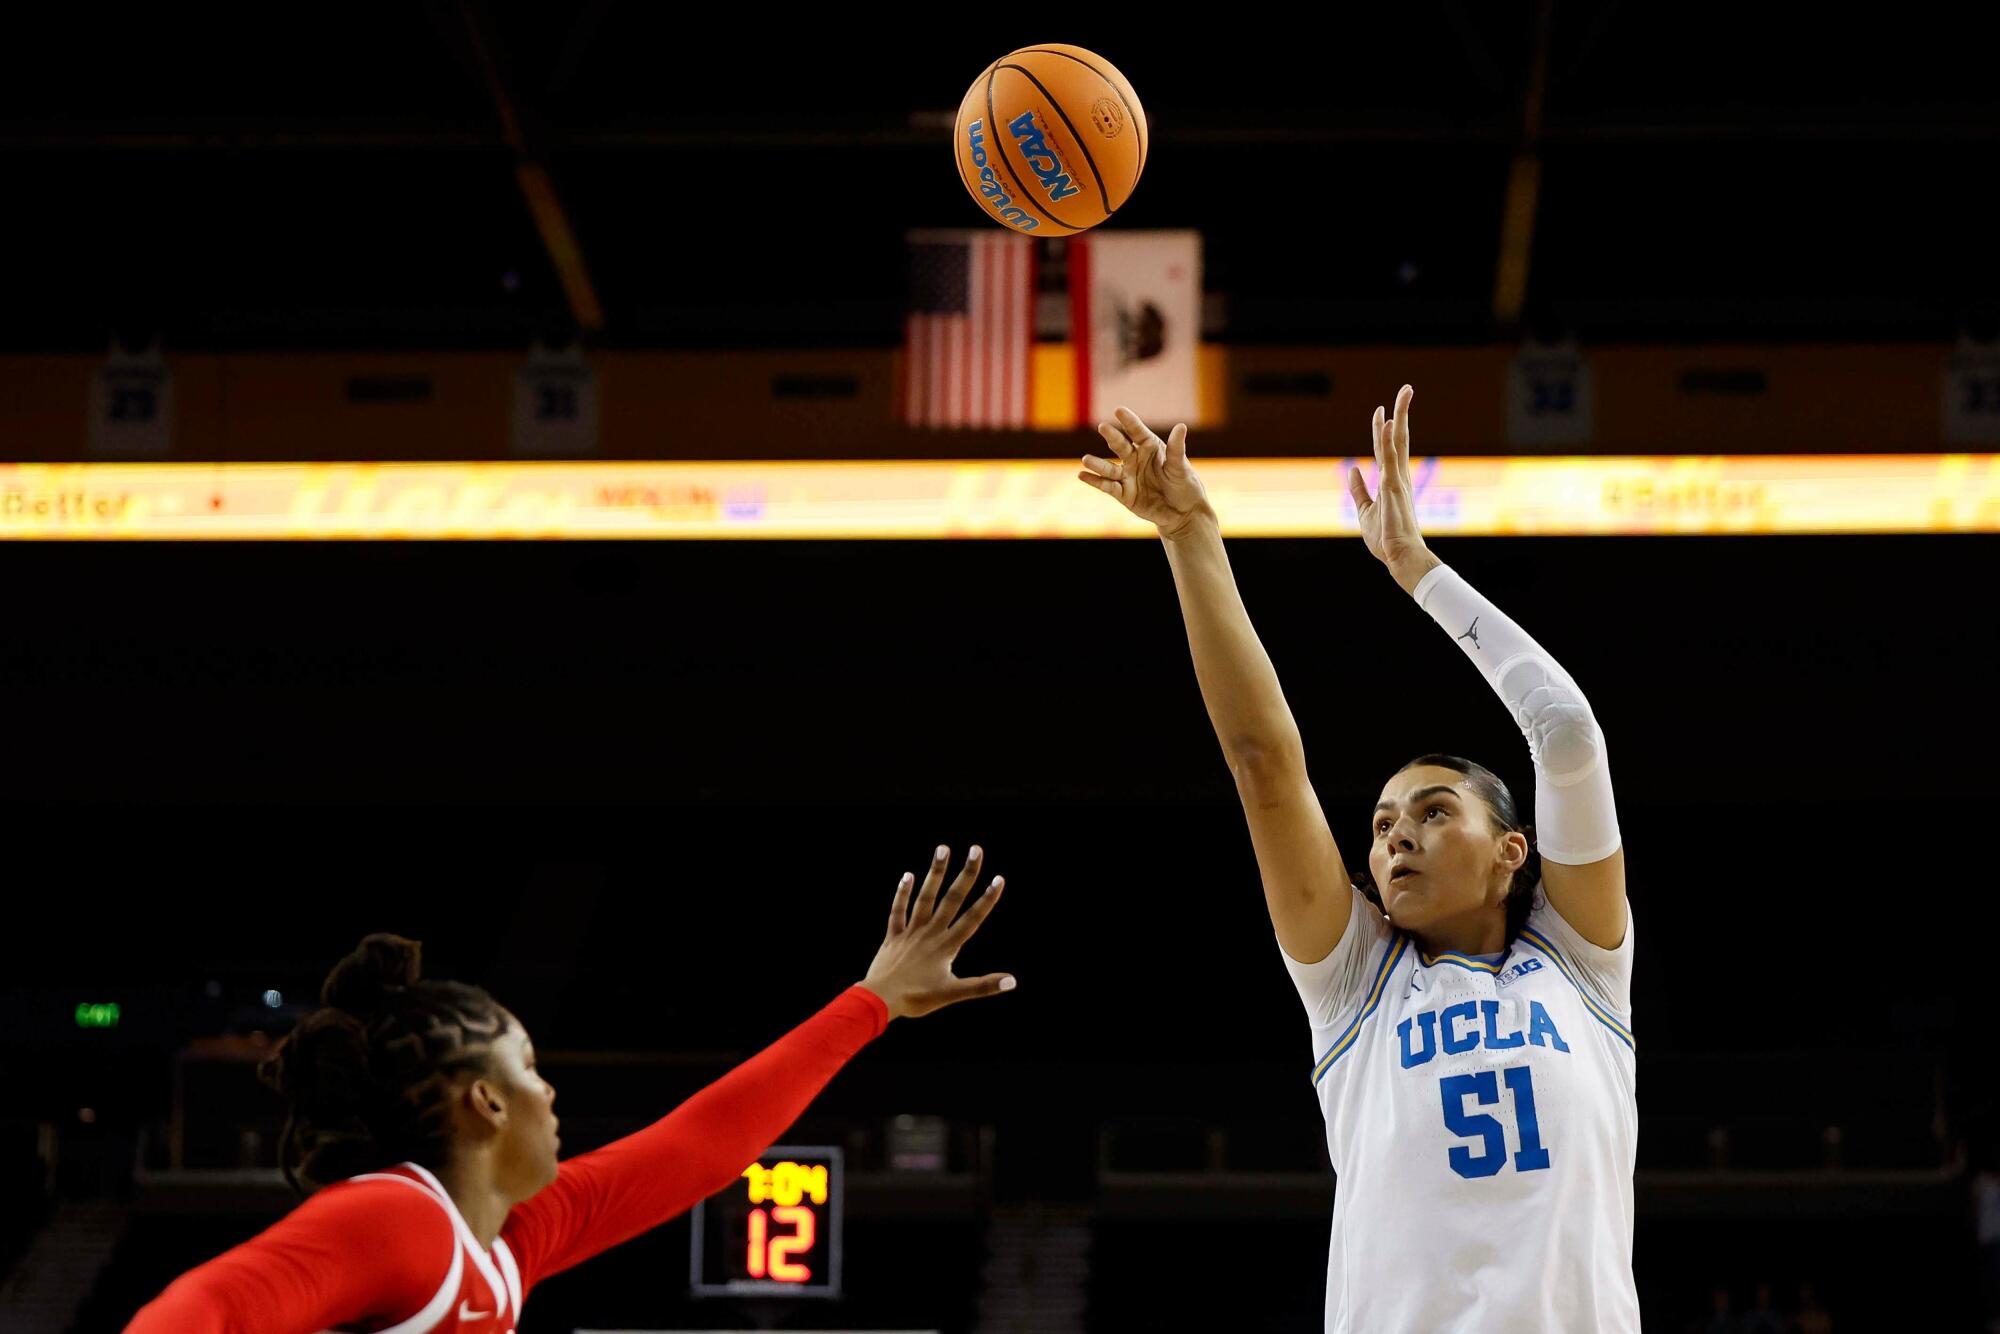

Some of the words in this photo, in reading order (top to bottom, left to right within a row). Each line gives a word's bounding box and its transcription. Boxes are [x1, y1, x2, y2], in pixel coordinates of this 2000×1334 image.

[968, 118, 1040, 231] Wilson
[1008, 111, 1080, 202] NCAA
[1397, 1000, 1570, 1069] UCLA
[1439, 1065, 1550, 1179] 51
[747, 1206, 816, 1282] 12
